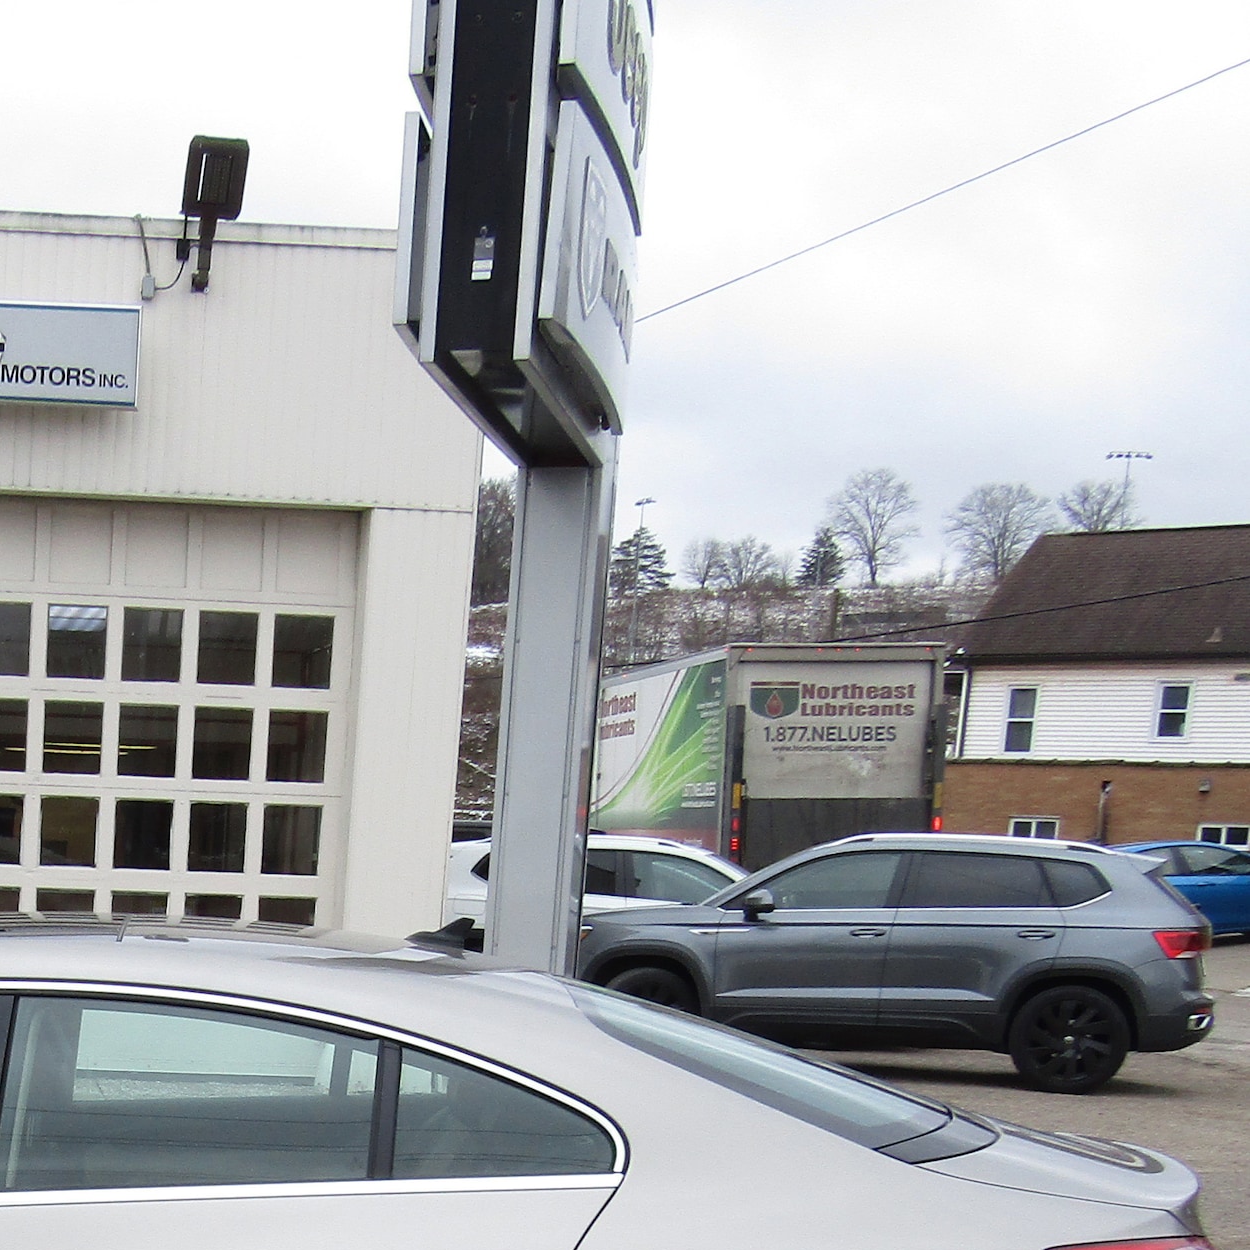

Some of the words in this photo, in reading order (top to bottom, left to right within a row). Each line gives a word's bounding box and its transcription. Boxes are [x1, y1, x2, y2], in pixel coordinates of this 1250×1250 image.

[1, 364, 96, 388] MOTORS
[98, 373, 129, 389] INC.
[801, 683, 917, 700] Northeast
[801, 702, 916, 717] Lubricants
[763, 725, 897, 742] 1.877.NELUBES
